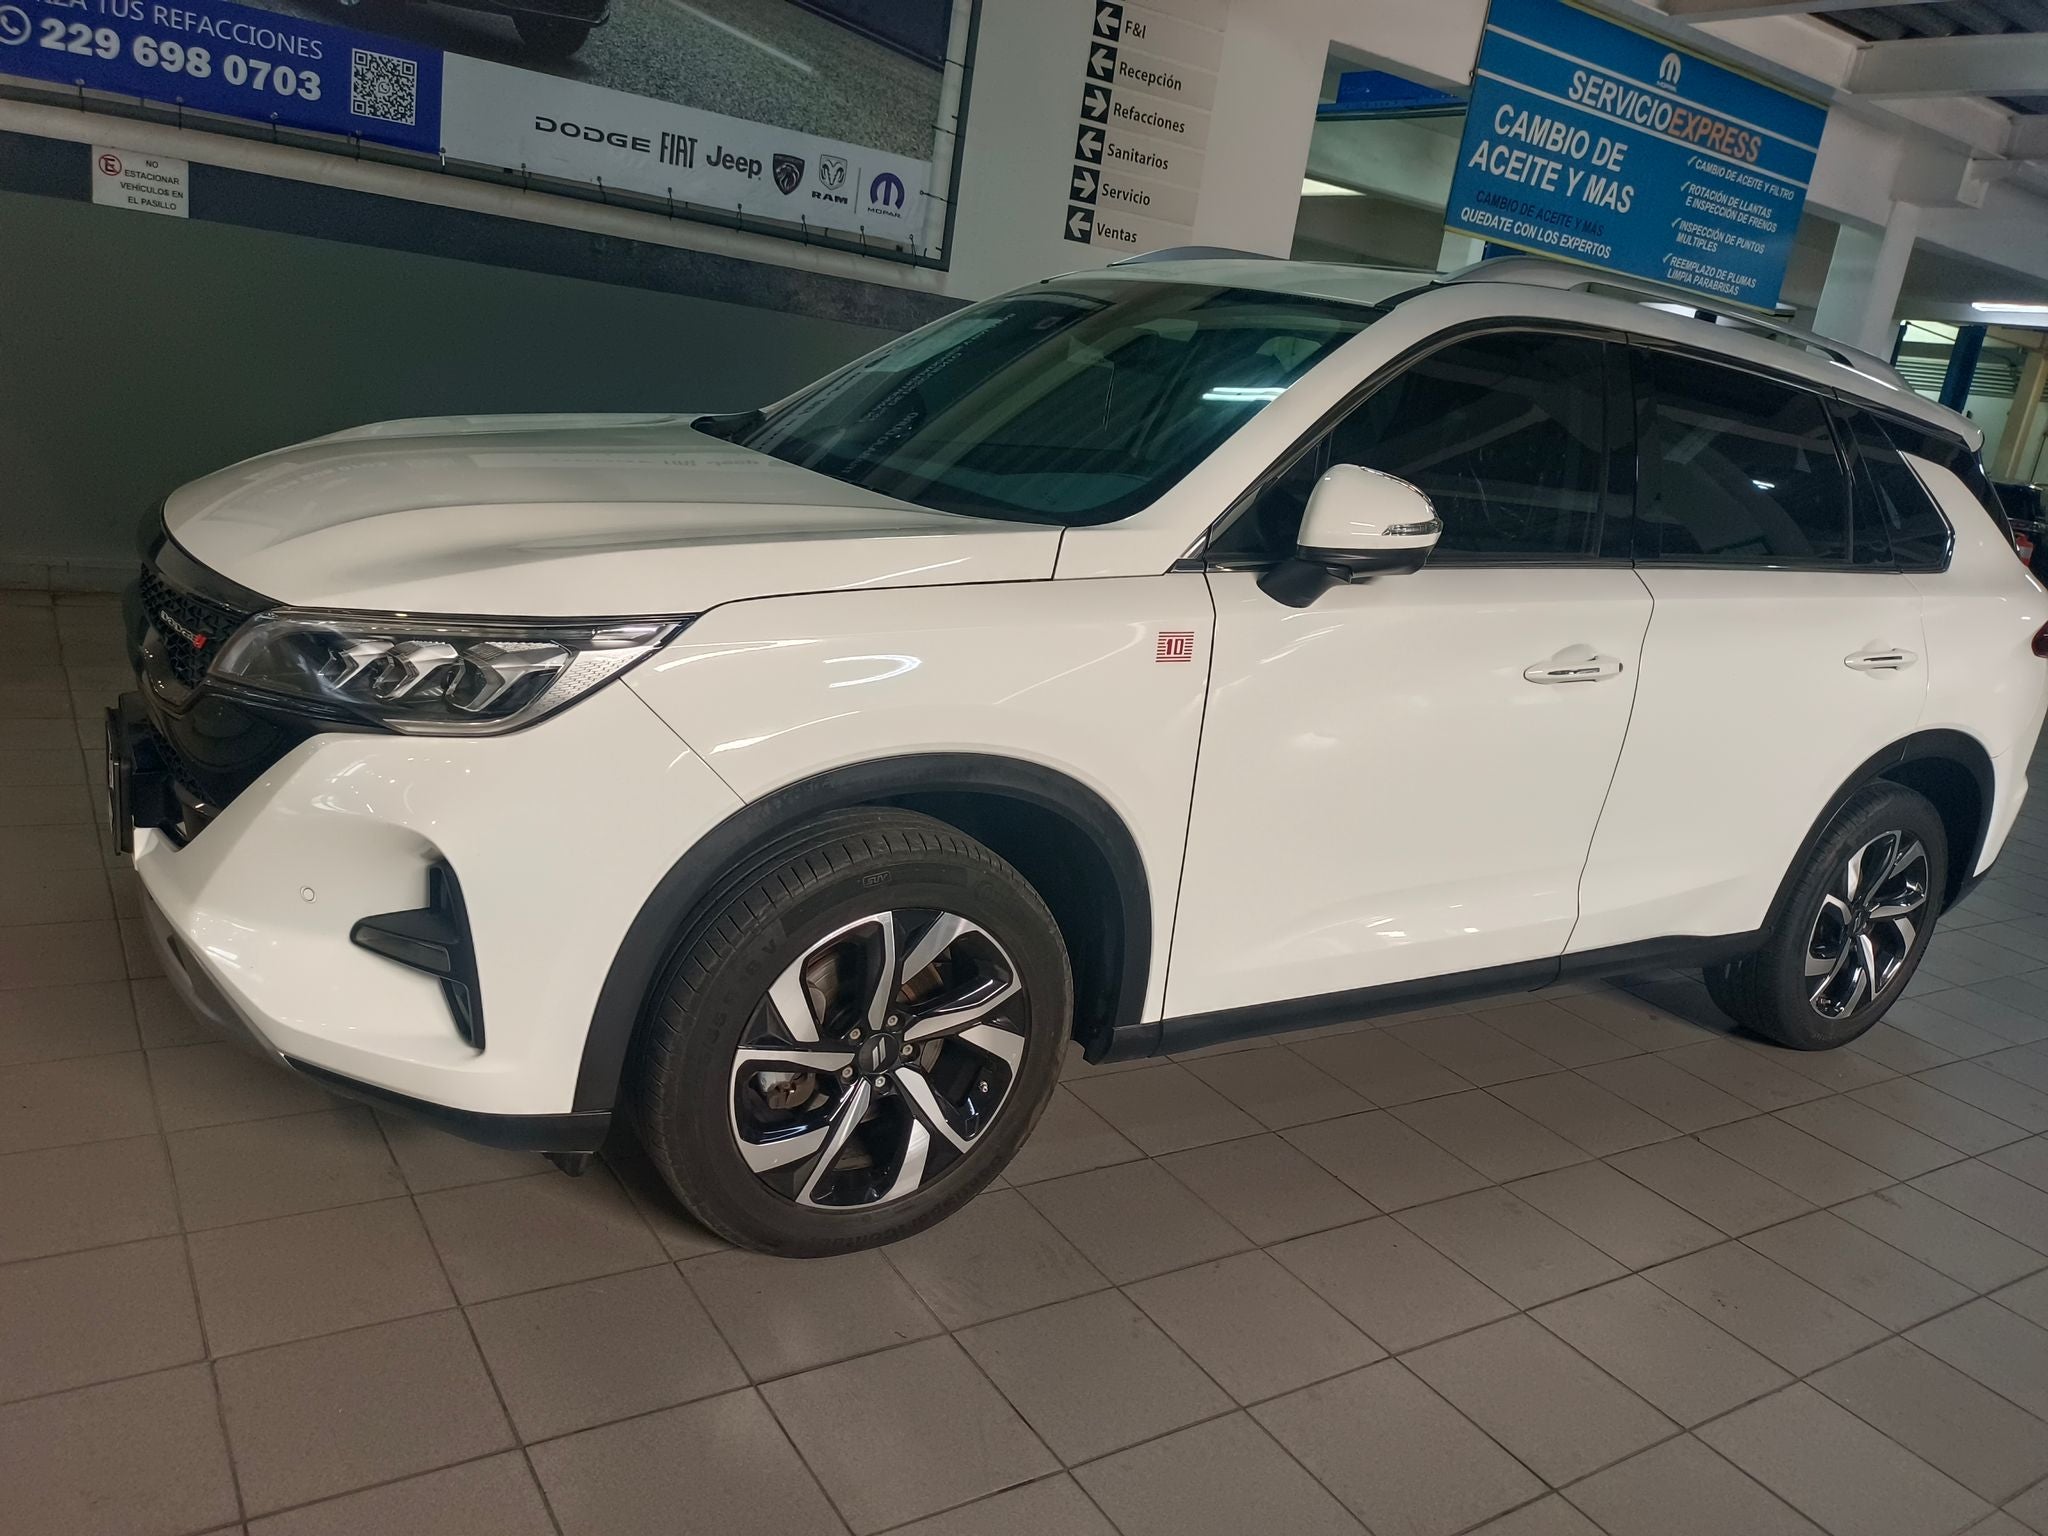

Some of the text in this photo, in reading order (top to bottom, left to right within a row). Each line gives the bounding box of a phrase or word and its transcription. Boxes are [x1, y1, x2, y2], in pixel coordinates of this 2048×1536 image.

[154, 5, 323, 60] REFACCIONES
[1125, 20, 1147, 39] F&I
[40, 18, 322, 101] 229 698 0703
[1119, 61, 1182, 91] Recepción
[1113, 102, 1185, 133] Refacciones
[535, 116, 763, 180] DODGE FIAT Jeep
[1494, 104, 1628, 172] CAMBIO DE
[146, 160, 158, 169] NO
[1107, 143, 1169, 170] Sanitarios
[124, 169, 180, 185] ESTACIONAR
[1468, 140, 1635, 214] ACEITE Y MAS
[1695, 159, 1726, 178] CAMBIO
[1724, 169, 1738, 182] DE
[1736, 173, 1766, 193] ACEITE
[1769, 184, 1795, 201] FILTRO
[128, 196, 177, 210] EL PASILLO
[171, 190, 184, 199] EN
[811, 191, 848, 204] RAM
[1101, 183, 1151, 206] Servicio
[1476, 190, 1518, 213] CAMBIO
[1519, 204, 1536, 218] DE
[1535, 208, 1573, 228] ACEITE
[1688, 183, 1773, 219] ROTACIÓN DE LLANTAS
[867, 207, 901, 219] MOPAR
[1685, 196, 1692, 207] E
[1737, 212, 1749, 224] DE
[1748, 216, 1778, 233] FRENOS
[1096, 222, 1138, 243] Ventas
[1460, 207, 1612, 259] QUEDATE CON LOS EXPERTOS
[1676, 232, 1718, 253] MULTIPLES
[1679, 220, 1766, 255] INSPECCIÓN DE PUNTOS
[1667, 268, 1740, 297] LIMPIA PARABRISAS
[1669, 256, 1758, 289] REEMPLAZO DE PLUMAS
[1166, 638, 1184, 655] 10
